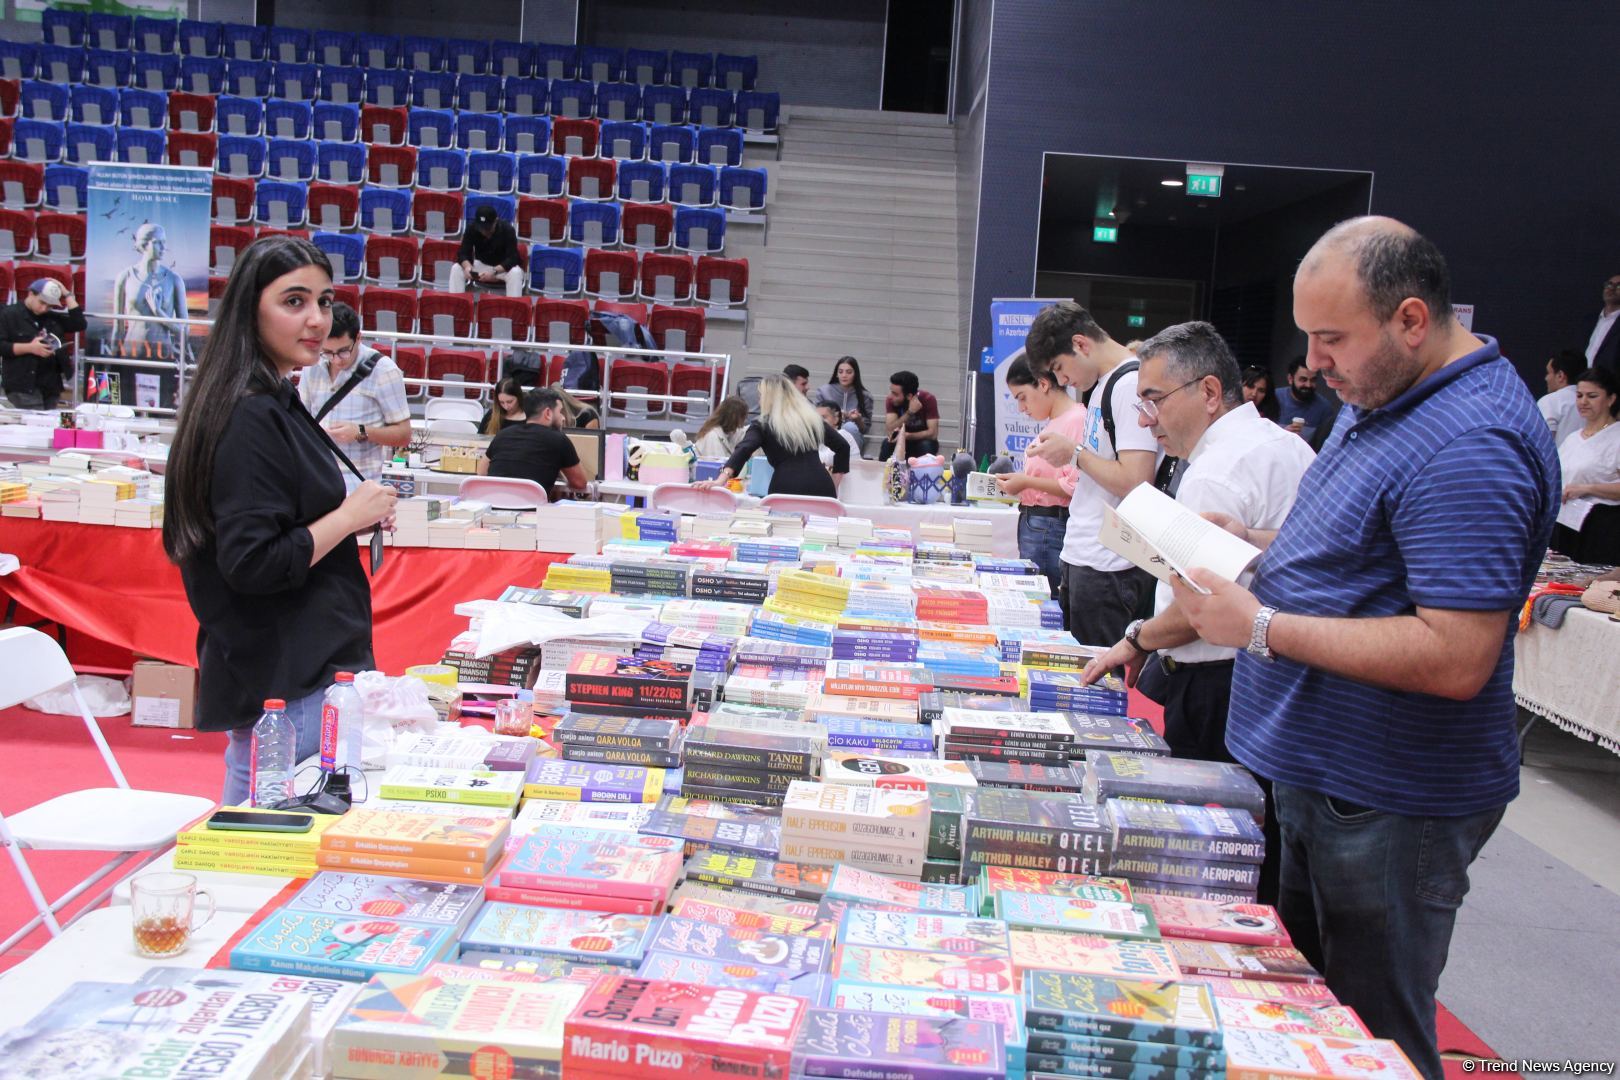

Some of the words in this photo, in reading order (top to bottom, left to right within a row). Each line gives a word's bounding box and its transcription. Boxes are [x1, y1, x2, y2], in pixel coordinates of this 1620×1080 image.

[1005, 423, 1031, 433] value
[461, 660, 490, 669] BRANSON
[459, 668, 488, 677] BRANSON
[569, 682, 609, 696] STEPHEN
[611, 685, 634, 698] KING
[639, 686, 682, 700] 11/22/63
[596, 735, 617, 746] QARA
[617, 736, 641, 748] VOLQA
[829, 736, 844, 746] ÇİO
[846, 738, 869, 747] KAKU
[606, 751, 627, 761] QARA
[627, 752, 651, 763] VOLQA
[687, 749, 723, 762] RICHARD
[724, 751, 761, 764] DAWKINS
[768, 752, 803, 765] TANRI
[687, 771, 722, 783] RICHARD
[724, 773, 761, 785] DAWKINS
[425, 788, 447, 800] PSİXO
[684, 793, 718, 803] RICHARD
[720, 795, 757, 805] DAWKINS
[808, 818, 847, 833] EPPERSON
[972, 827, 1014, 842] ARTHUR
[1017, 830, 1054, 846] HAILEY
[1060, 832, 1105, 853] OTEL
[1124, 834, 1165, 849] ARTHUR
[1168, 837, 1204, 852] HAILEY
[1209, 841, 1261, 857] AEROPORT
[807, 846, 845, 860] EPPERSON
[970, 850, 1013, 866] ARTHUR
[1015, 853, 1052, 869] HAILEY
[1058, 855, 1103, 875] OTEL
[1117, 859, 1159, 875] ARTHUR
[1162, 862, 1199, 878] HAILEY
[1202, 867, 1255, 884] AEROPORT
[220, 993, 285, 1030] NESBO
[686, 989, 747, 1041] Mario
[731, 995, 799, 1046] Puzo
[571, 1035, 629, 1062] Mario
[635, 1043, 684, 1069] Puzo
